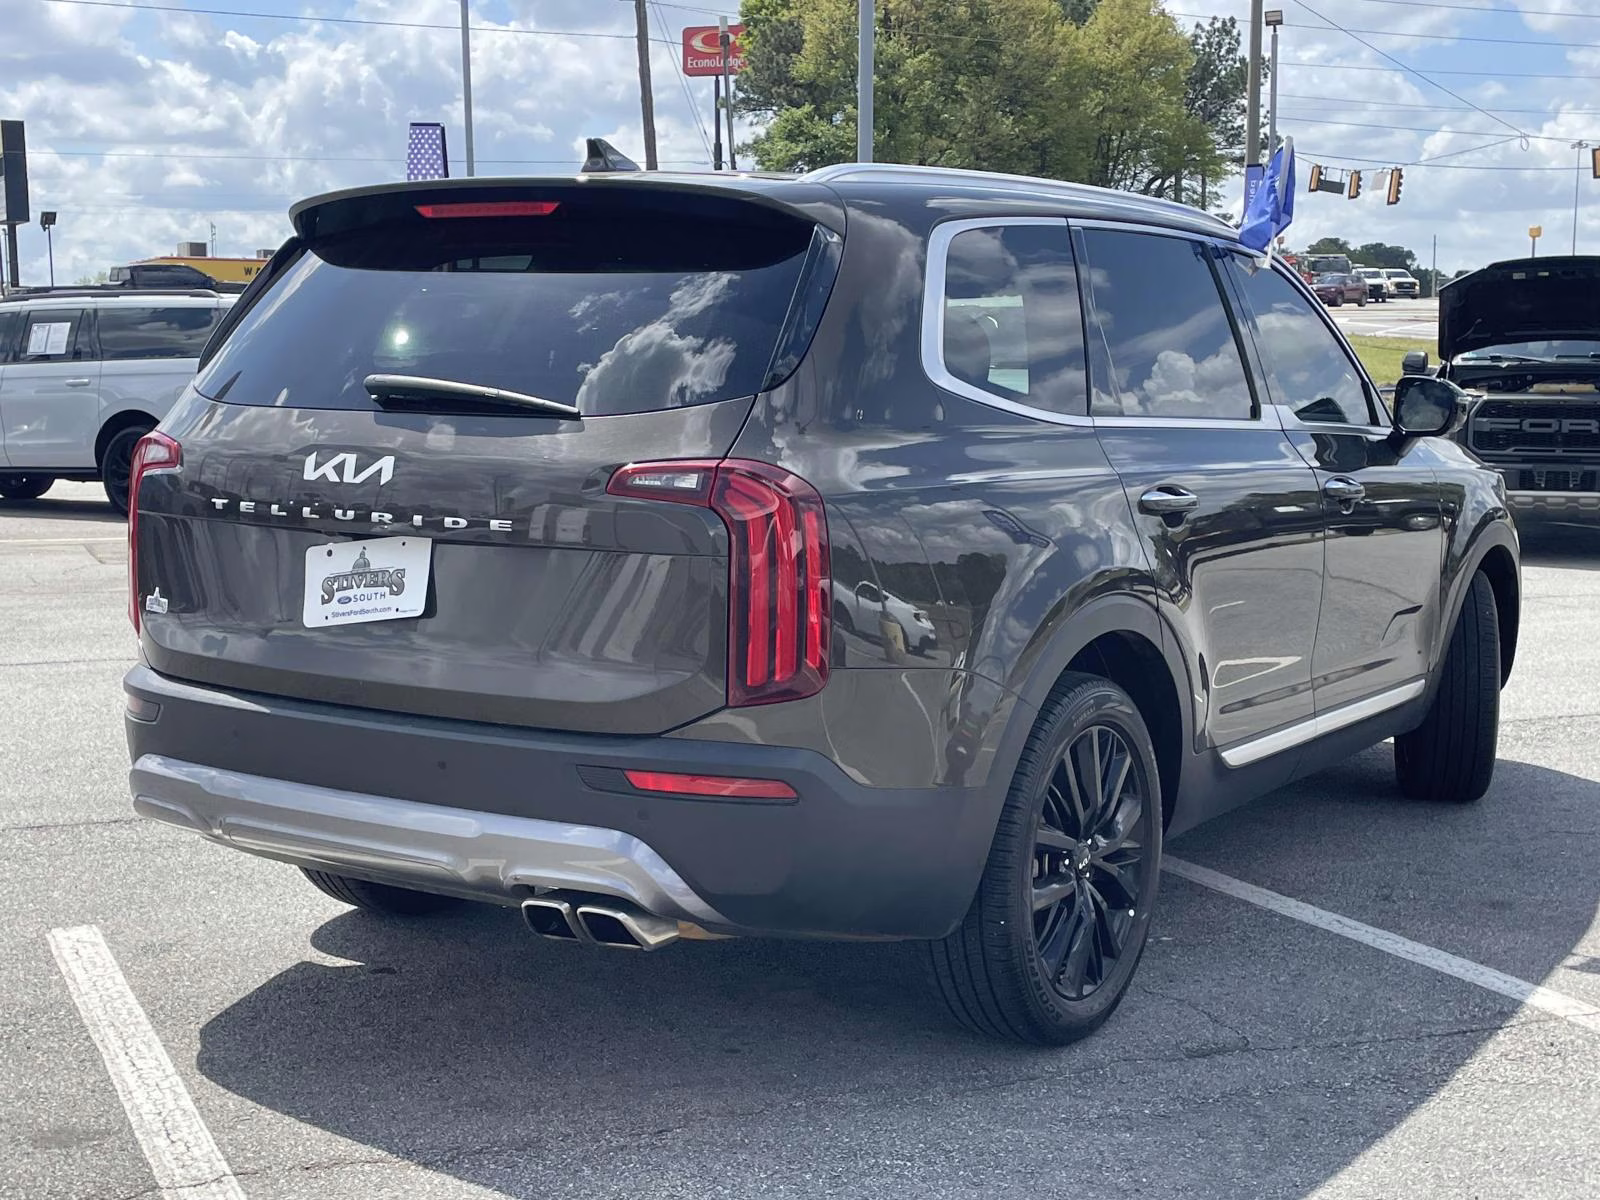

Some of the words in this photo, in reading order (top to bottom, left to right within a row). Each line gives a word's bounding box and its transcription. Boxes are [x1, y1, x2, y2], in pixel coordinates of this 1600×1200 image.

[303, 451, 395, 486] KIA
[211, 498, 513, 532] TELLURIDE
[321, 568, 405, 605] STIVERS
[353, 592, 386, 602] SOUTH
